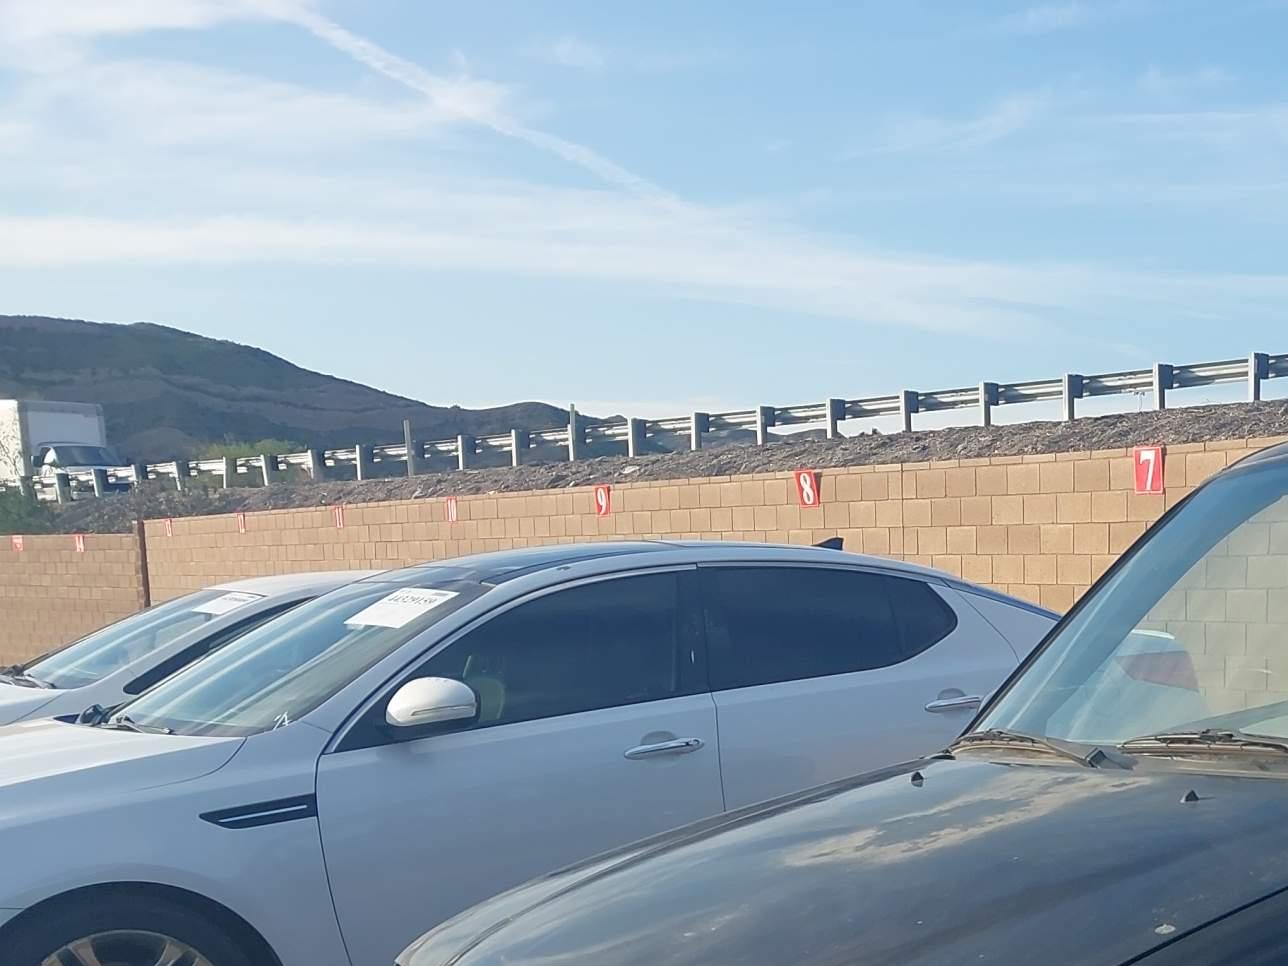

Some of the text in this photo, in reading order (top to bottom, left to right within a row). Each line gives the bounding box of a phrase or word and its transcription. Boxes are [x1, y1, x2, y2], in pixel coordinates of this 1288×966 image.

[1139, 449, 1156, 492] 7
[597, 487, 608, 515] 9
[799, 472, 814, 505] 8
[447, 498, 458, 523] 10
